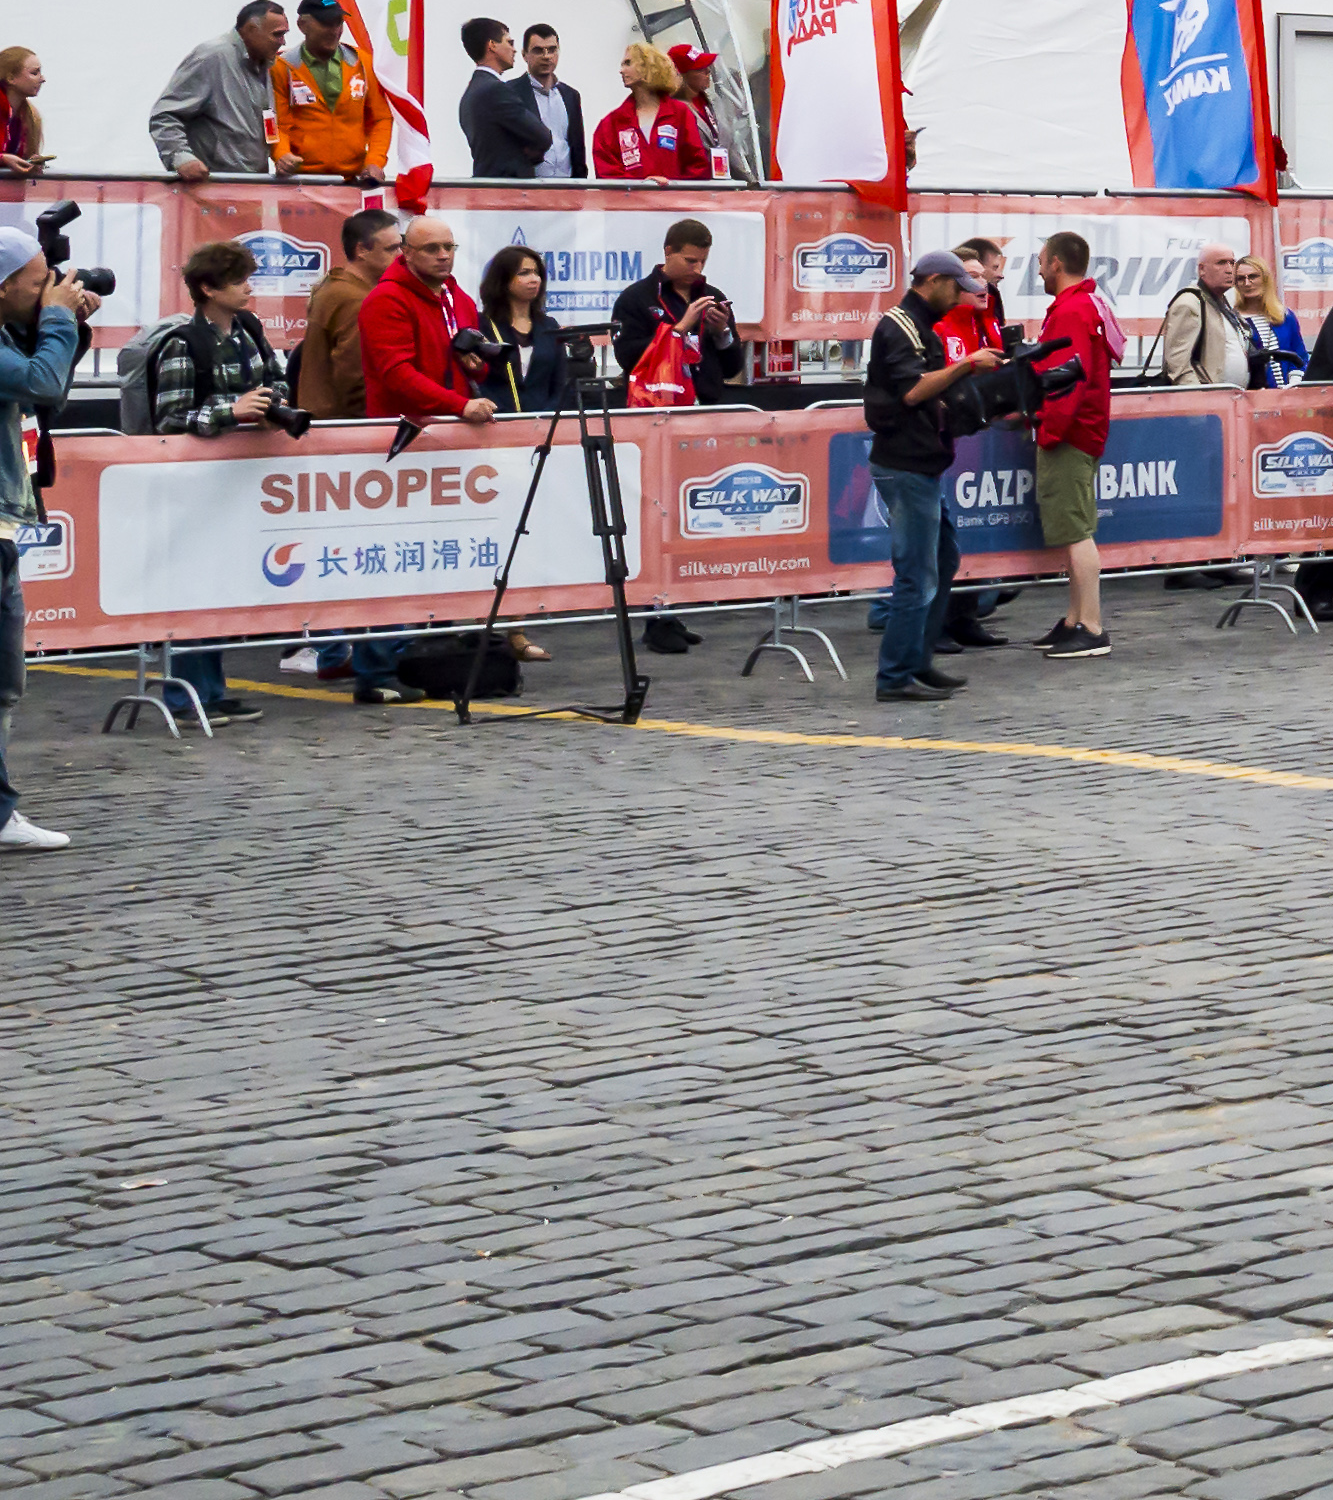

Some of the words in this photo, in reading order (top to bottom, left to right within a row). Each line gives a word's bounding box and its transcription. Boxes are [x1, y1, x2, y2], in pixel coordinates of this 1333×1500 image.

[269, 254, 316, 267] WAY
[543, 251, 643, 282] АЗПРОМ
[804, 254, 846, 266] SILK
[847, 254, 883, 266] WAY
[1265, 454, 1306, 469] SILK
[260, 464, 500, 515] SINOPEC
[695, 489, 749, 507] SILK
[752, 486, 797, 504] WAY
[957, 515, 984, 528] Bank
[316, 536, 500, 578] 长城润滑油
[679, 557, 810, 577] silkwayrally.com
